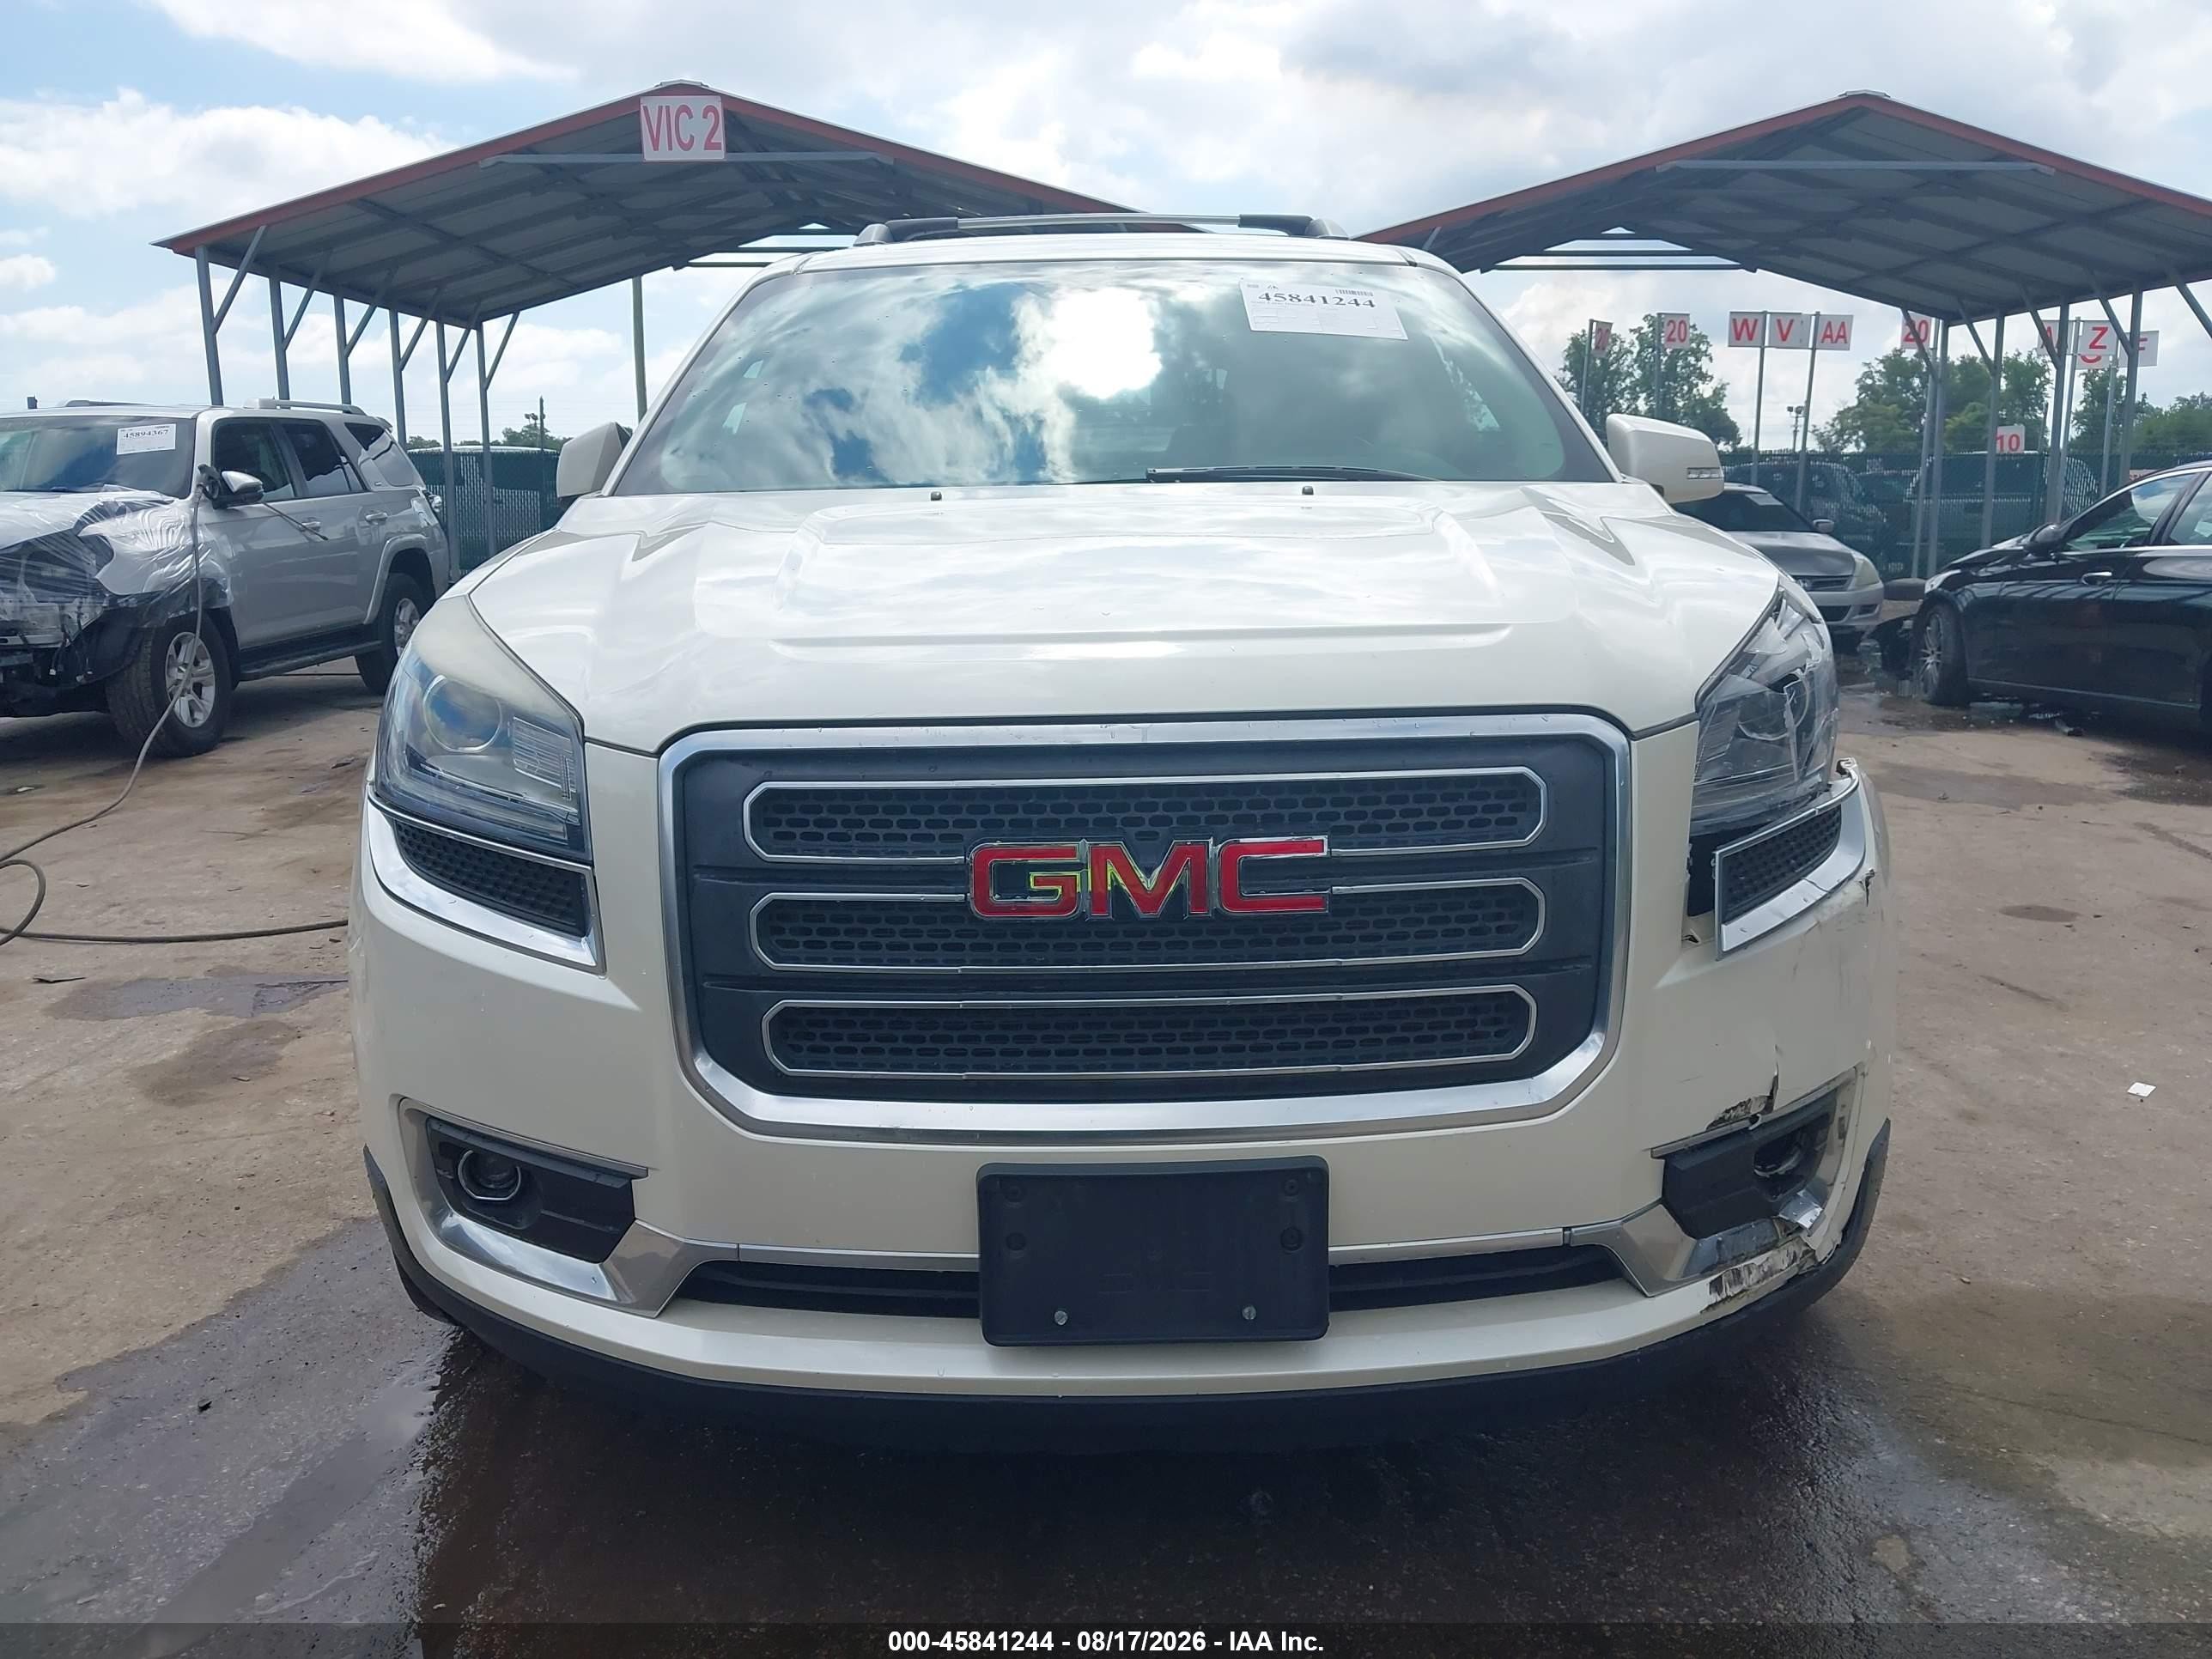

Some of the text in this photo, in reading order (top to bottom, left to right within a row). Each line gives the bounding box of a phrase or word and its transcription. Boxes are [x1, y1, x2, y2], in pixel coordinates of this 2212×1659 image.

[642, 105, 721, 151] VIC 2
[1259, 292, 1376, 307] 45841244
[1666, 319, 1687, 343] 20
[1732, 318, 1759, 341] W
[1777, 319, 1794, 342] V
[1820, 321, 1848, 343] AA
[2088, 326, 2108, 349] Z
[1995, 434, 2021, 453] 10
[969, 835, 1328, 921] GMC
